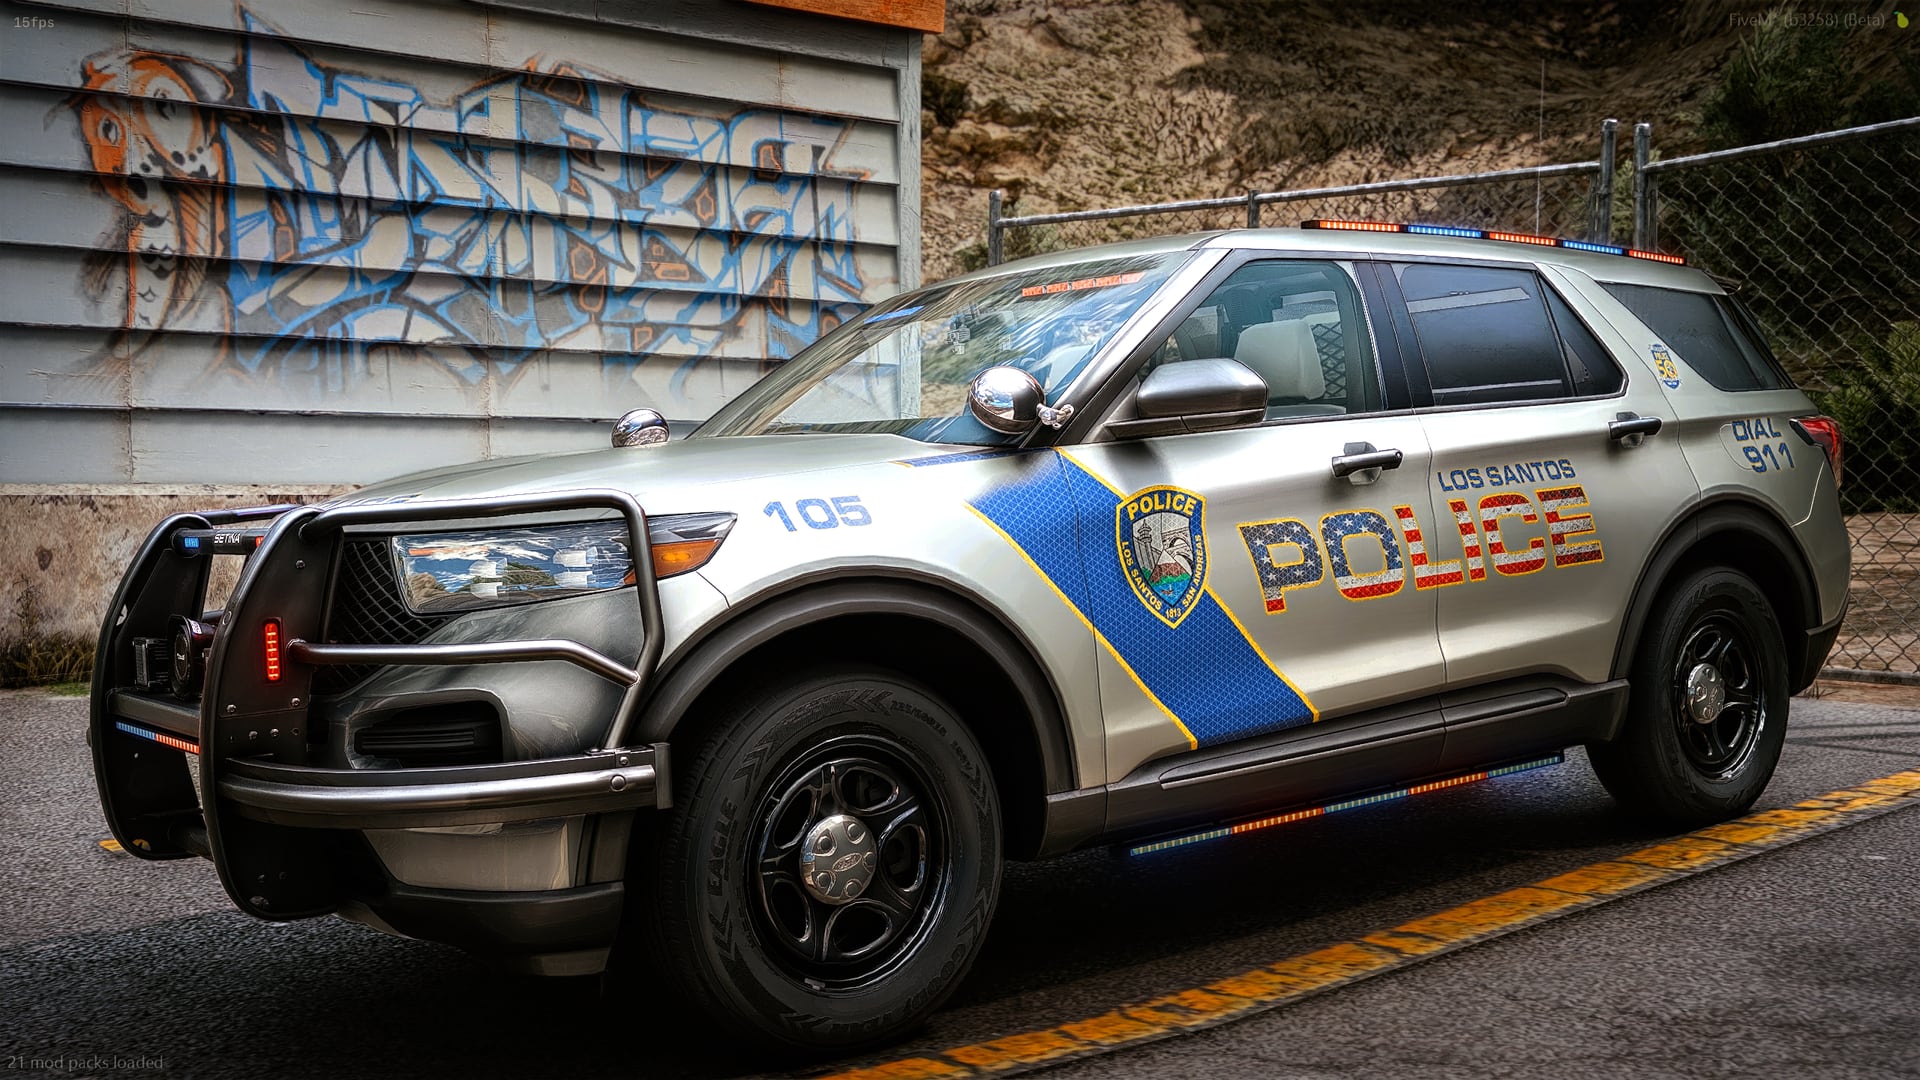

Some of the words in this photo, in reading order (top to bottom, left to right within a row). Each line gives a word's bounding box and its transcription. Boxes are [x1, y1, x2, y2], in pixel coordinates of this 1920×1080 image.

[1732, 417, 1781, 441] DIAL
[1437, 468, 1484, 492] LOS
[1485, 459, 1576, 487] SANTOS
[1743, 443, 1795, 473] 911
[763, 495, 873, 532] 105
[1127, 493, 1197, 521] POLICE
[1236, 484, 1604, 615] POLICE
[1121, 541, 1133, 566] LOS
[1131, 570, 1163, 611] SANTOS
[1182, 588, 1197, 608] SAN
[1194, 534, 1205, 587] ANDREAS
